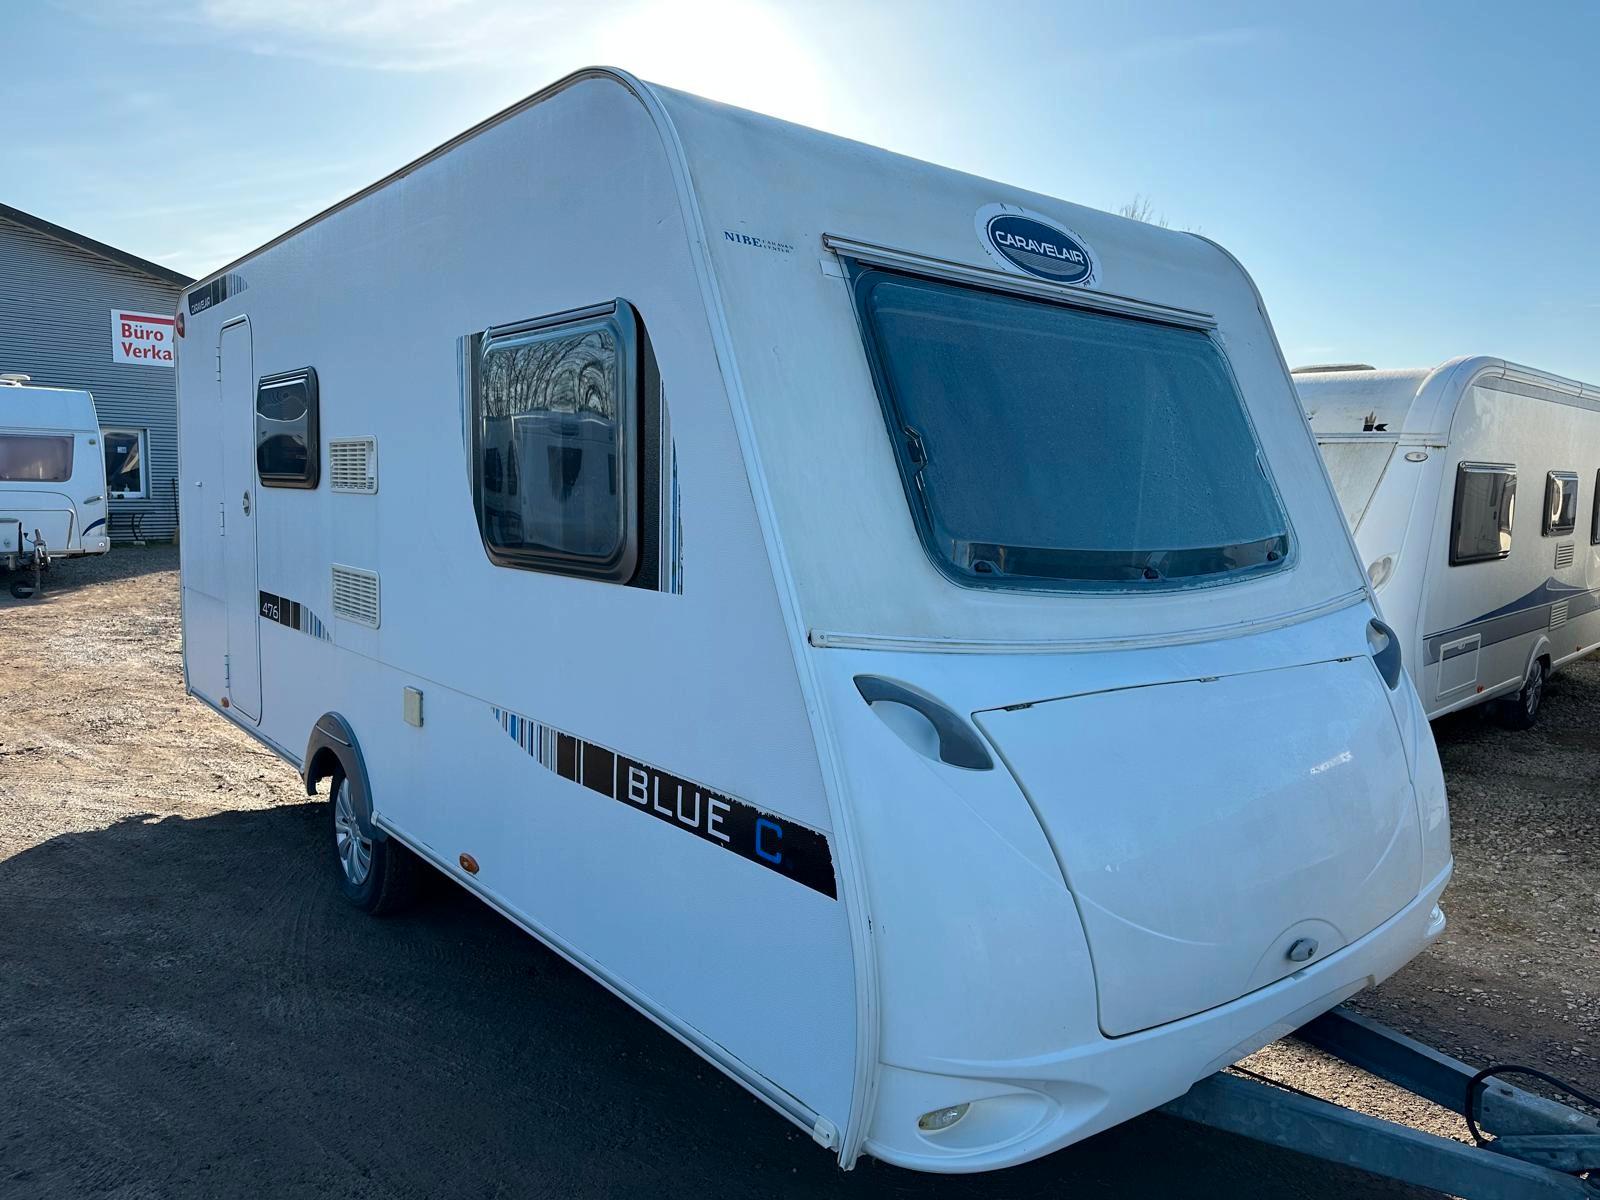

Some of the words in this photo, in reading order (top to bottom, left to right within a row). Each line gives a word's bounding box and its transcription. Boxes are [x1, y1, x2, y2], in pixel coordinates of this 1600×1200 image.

[995, 231, 1084, 264] CARAVELAIR
[121, 322, 164, 341] Büro
[262, 602, 279, 619] 476
[628, 766, 731, 843] BLUE
[756, 817, 783, 865] C
